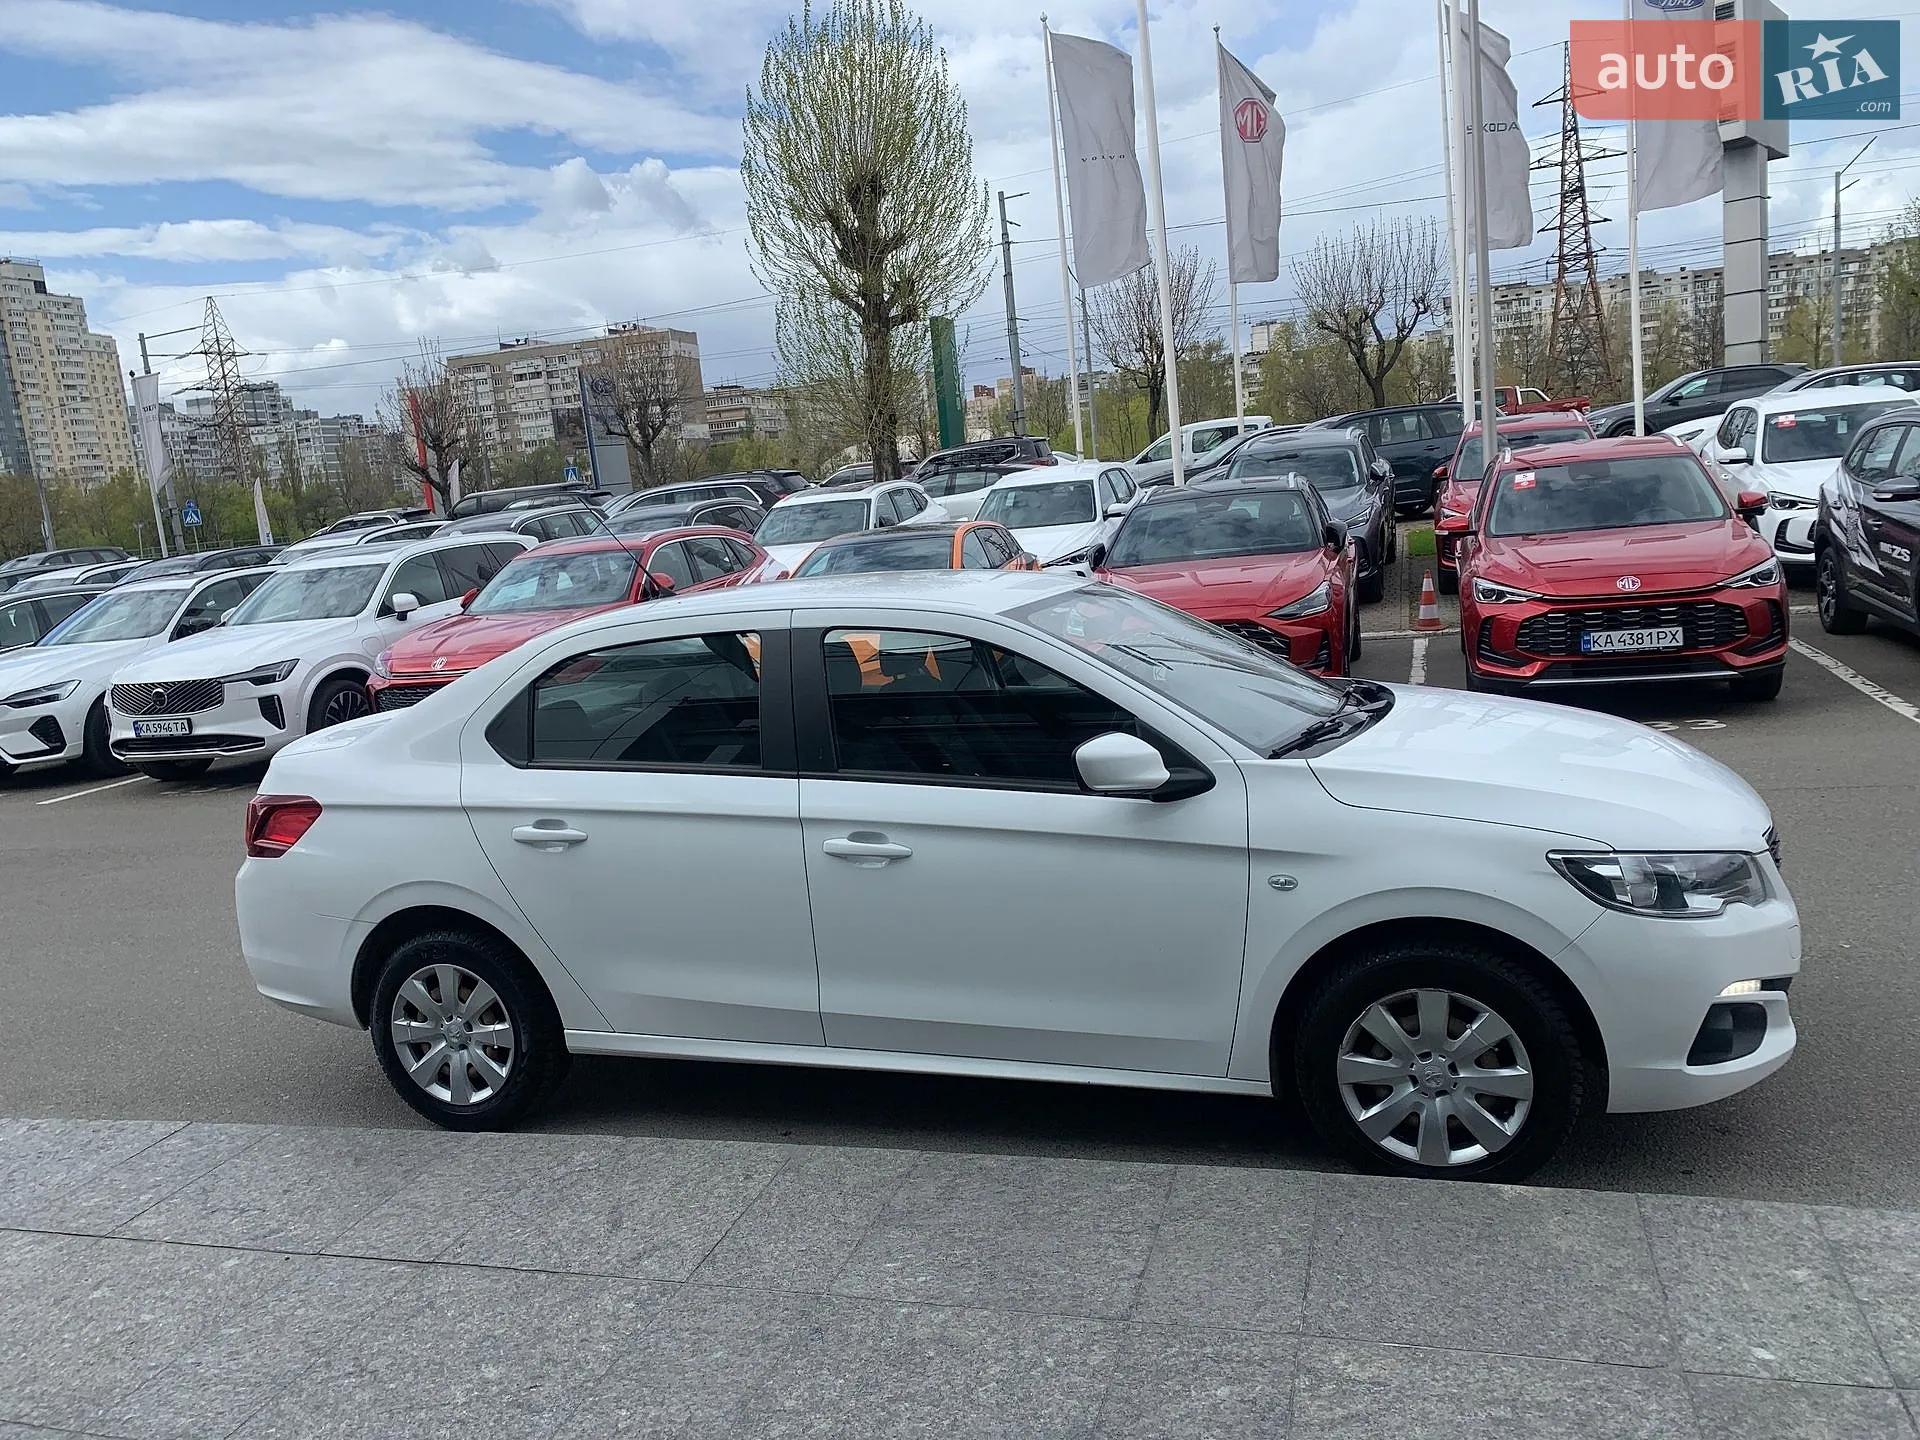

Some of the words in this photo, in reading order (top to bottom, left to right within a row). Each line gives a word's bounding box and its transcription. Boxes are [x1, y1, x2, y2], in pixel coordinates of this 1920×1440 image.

[1236, 101, 1267, 138] MG
[1891, 545, 1911, 562] ZS
[1619, 576, 1640, 590] MG
[1592, 634, 1615, 649] KA
[1617, 632, 1653, 647] 4381
[1656, 629, 1680, 645] PX
[140, 723, 152, 734] KA
[152, 722, 173, 734] 5946
[173, 721, 188, 733] TA
